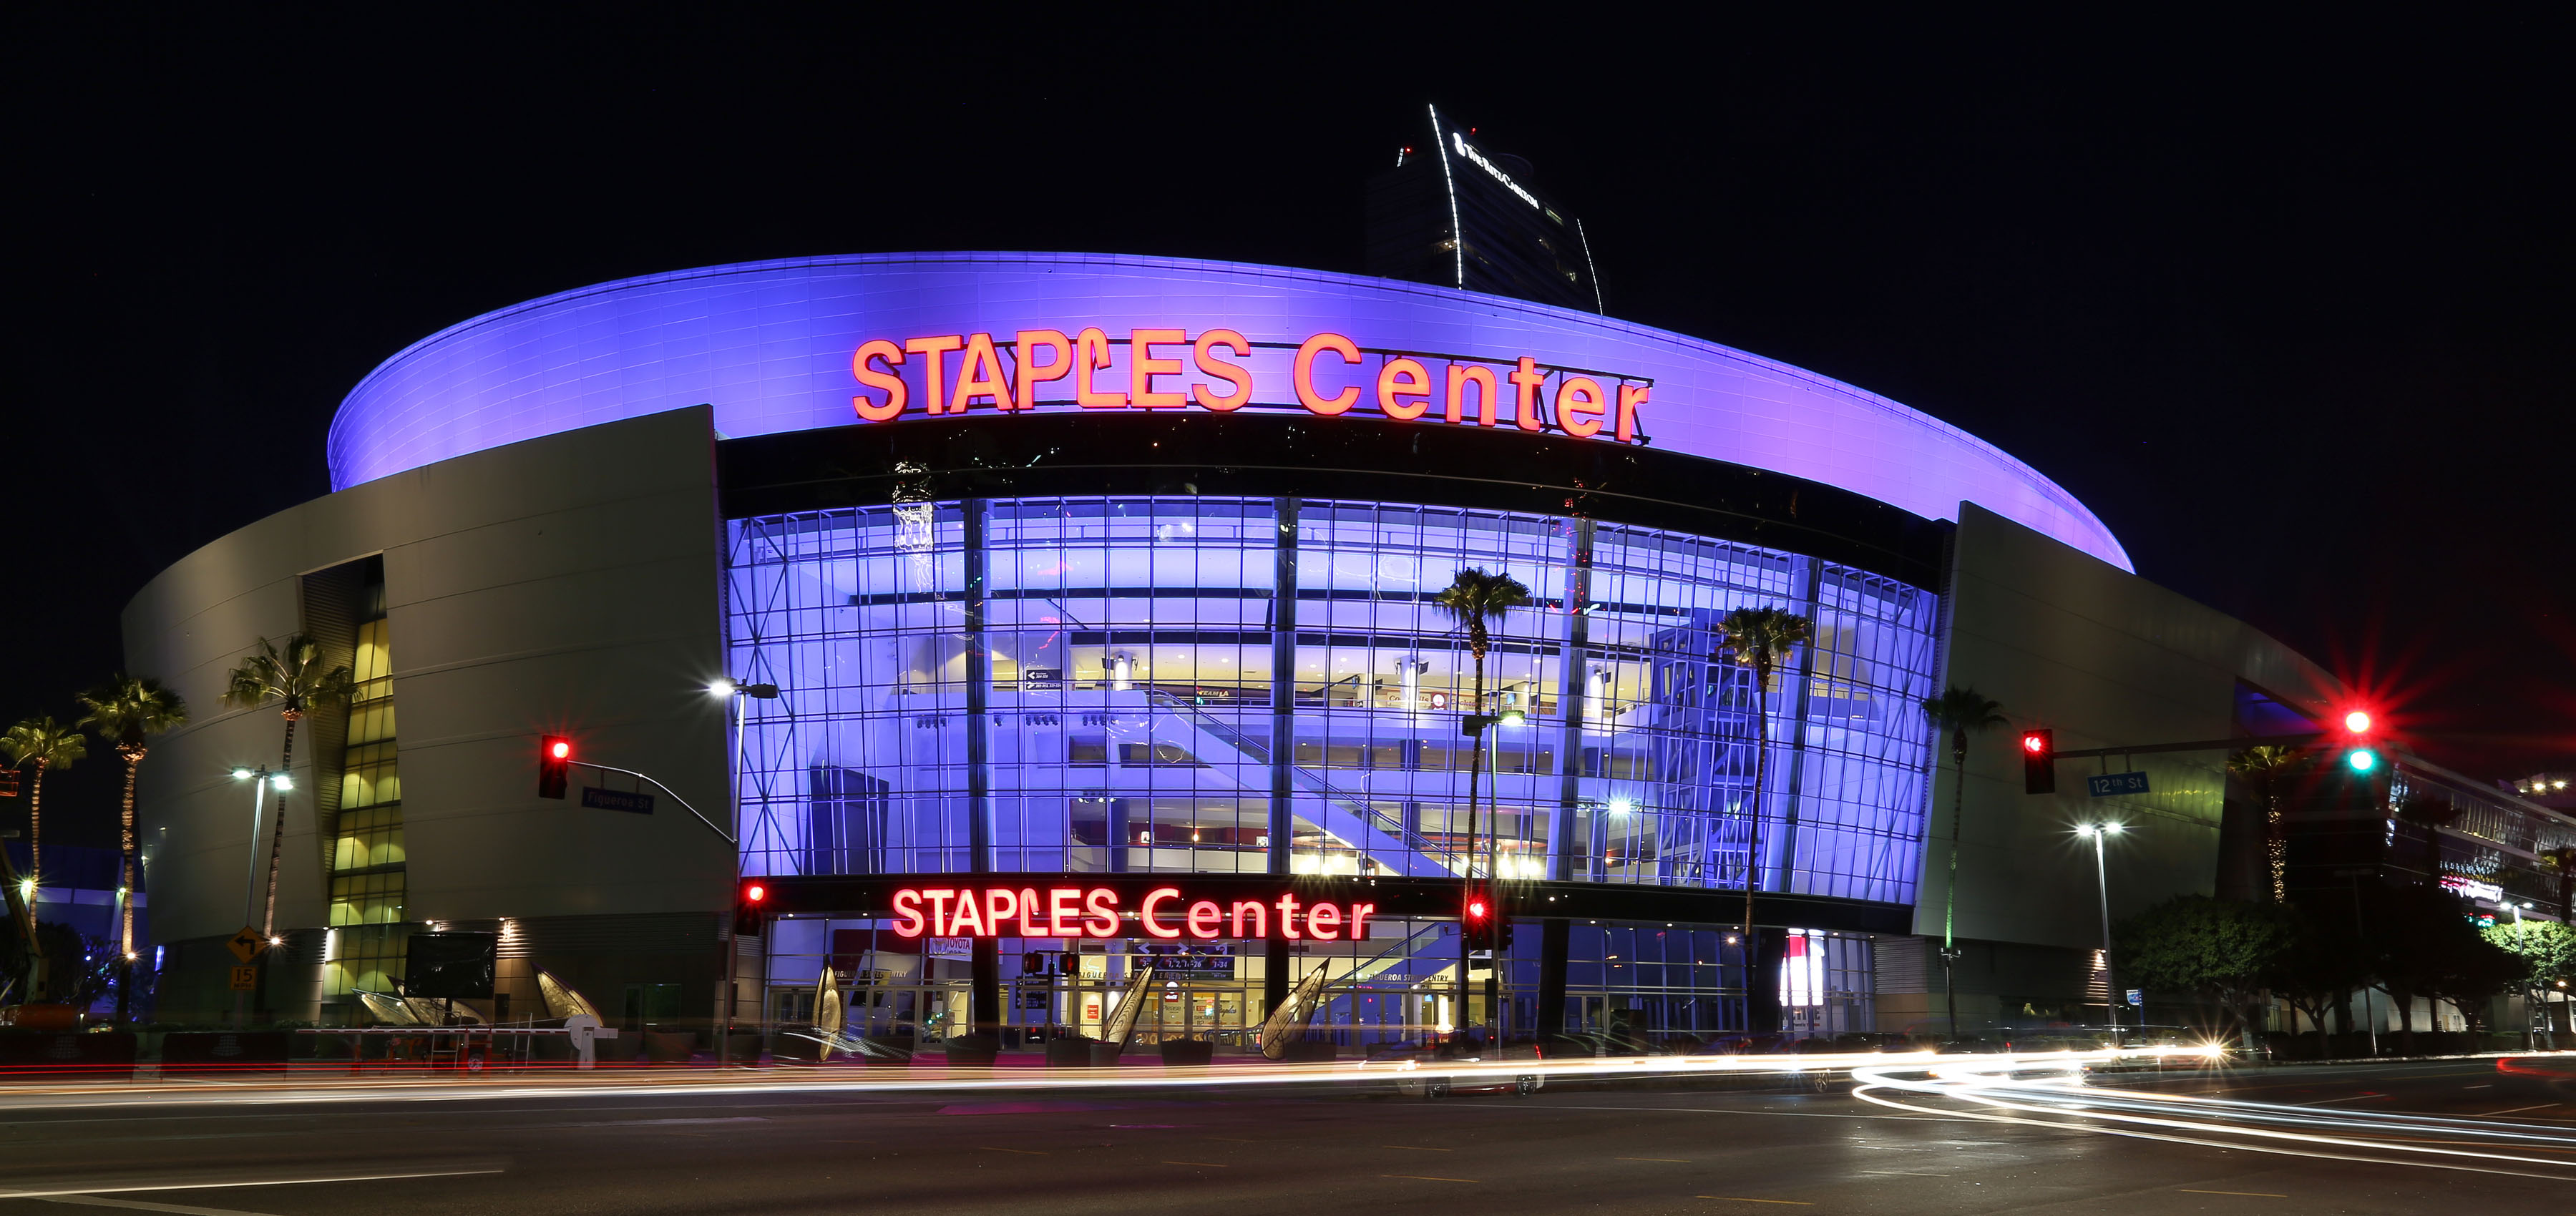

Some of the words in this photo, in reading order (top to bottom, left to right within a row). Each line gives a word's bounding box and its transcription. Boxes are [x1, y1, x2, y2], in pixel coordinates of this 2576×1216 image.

[1463, 143, 1483, 167] THE
[852, 326, 1254, 423] STAPLES
[1293, 333, 1650, 443] Center
[1451, 698, 1485, 707] Ccktas
[2094, 778, 2122, 793] 12th
[2128, 778, 2143, 789] St
[588, 791, 633, 807] Figueroa
[638, 798, 648, 809] St
[892, 888, 1121, 938] STAPLES
[1141, 888, 1375, 941] Center
[946, 938, 970, 950] TOYOTA
[237, 969, 252, 982] 15
